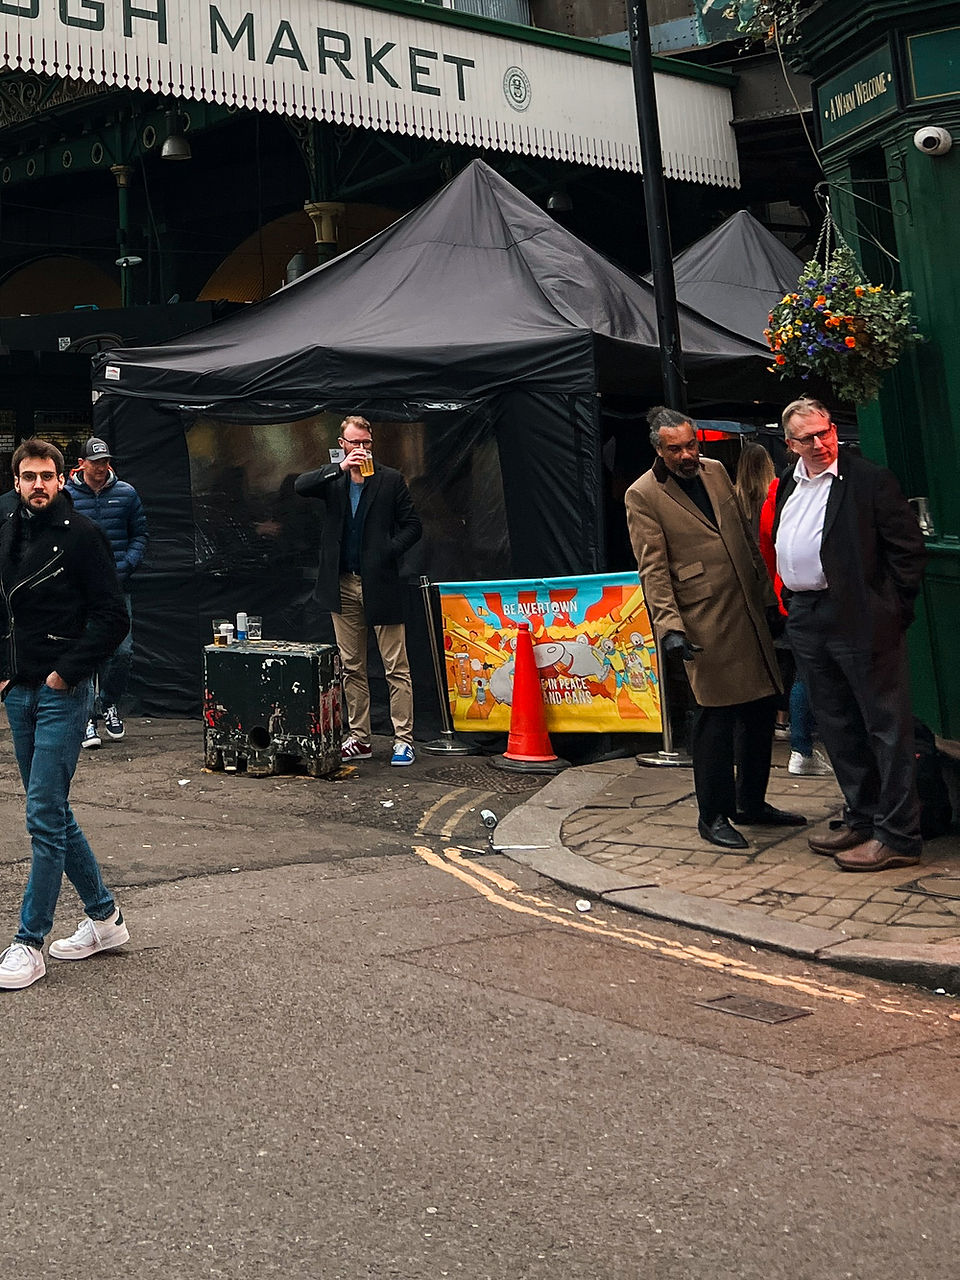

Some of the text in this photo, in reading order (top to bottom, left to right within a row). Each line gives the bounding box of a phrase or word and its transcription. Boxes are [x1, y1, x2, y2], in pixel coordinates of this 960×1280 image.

[209, 4, 476, 103] MARKET
[503, 600, 578, 616] BEAVERTOWN
[547, 677, 557, 690] IN
[559, 677, 591, 690] PEACE
[543, 689, 593, 705] AND CANS
